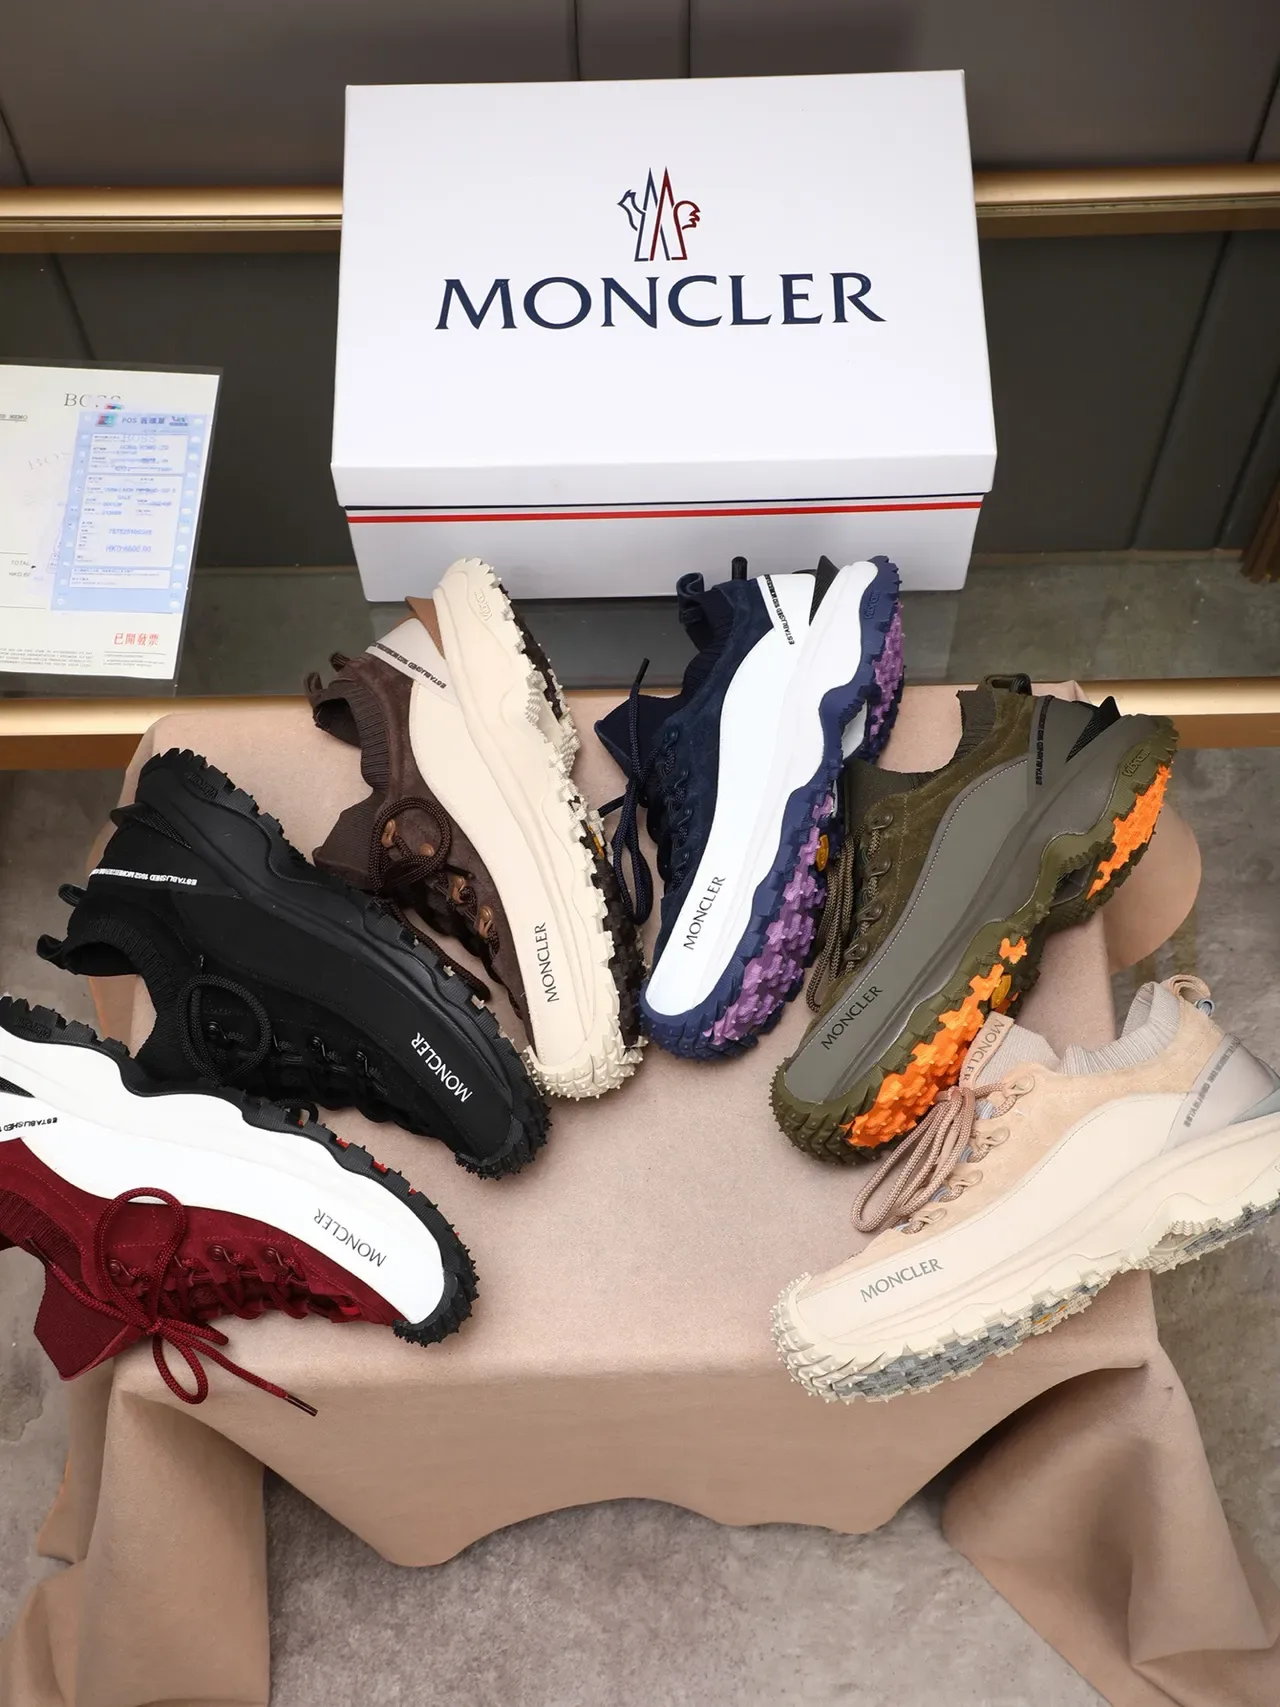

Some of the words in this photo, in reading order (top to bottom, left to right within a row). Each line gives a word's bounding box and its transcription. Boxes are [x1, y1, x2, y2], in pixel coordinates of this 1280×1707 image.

[435, 272, 887, 330] MONCLER
[113, 632, 160, 646] 已開發票
[149, 874, 198, 886] ESTABLISHED
[683, 876, 726, 951] MONCLER
[534, 921, 561, 1003] MONCLER
[820, 985, 884, 1051] MONCLER
[410, 1031, 474, 1103] MONCLER
[963, 1018, 1005, 1081] MONCLER
[3, 1116, 59, 1132] ESTABLISHED
[313, 1207, 388, 1268] MONCLER
[859, 1258, 945, 1303] MONCLER
